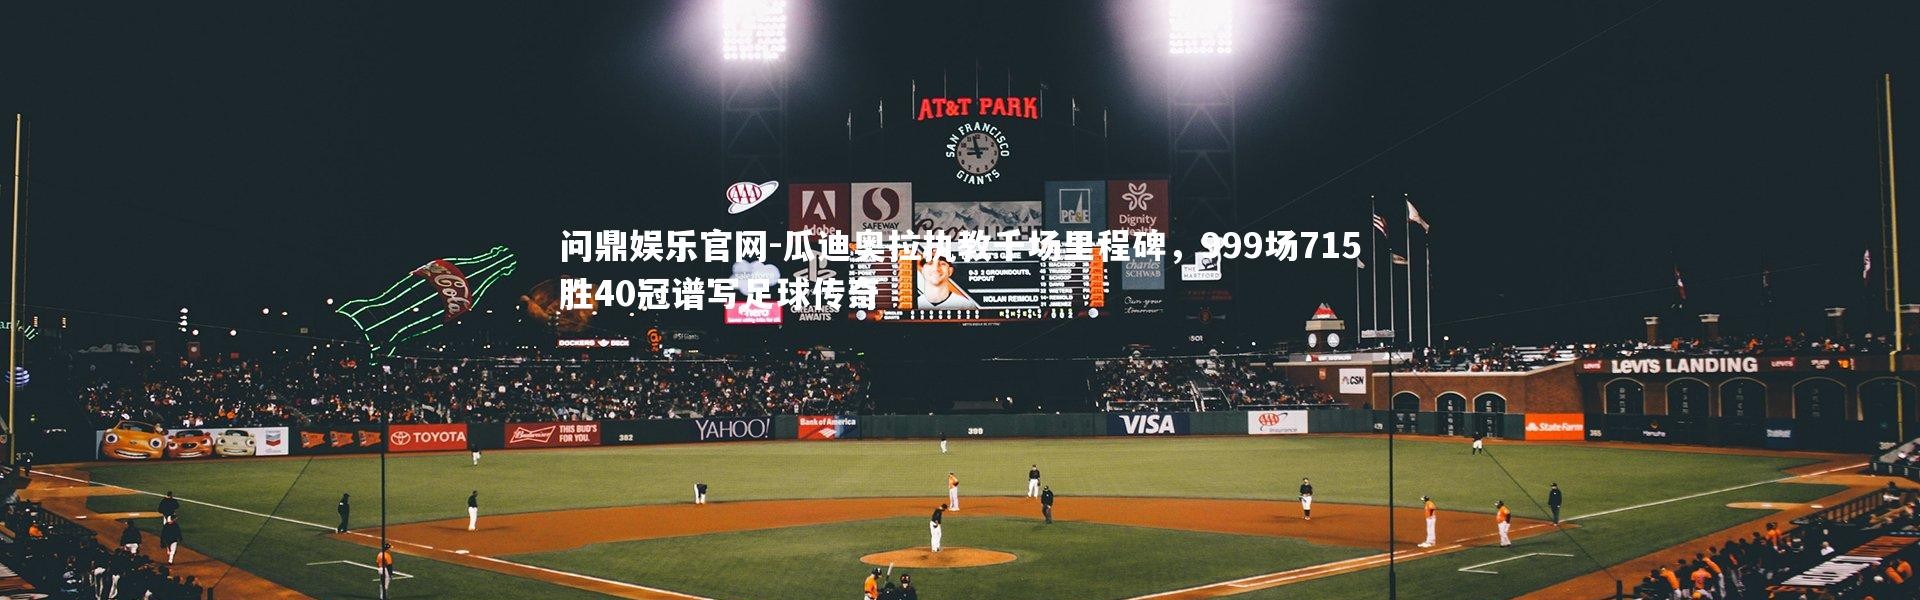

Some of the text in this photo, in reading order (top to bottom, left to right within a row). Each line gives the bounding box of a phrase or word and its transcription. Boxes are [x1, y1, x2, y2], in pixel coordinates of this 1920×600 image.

[918, 96, 1038, 120] AT&T PARK
[946, 122, 1010, 158] SAN FRANCISCO
[956, 169, 1001, 185] GIANTS
[1061, 209, 1090, 222] PG&E
[1119, 214, 1157, 227] Dignity
[862, 222, 899, 230] SAFEWAY
[985, 269, 1032, 277] GROUNDOUTS,
[1125, 270, 1161, 278] SCHWAB
[1008, 295, 1039, 303] REIMOLD
[1143, 299, 1162, 308] your
[799, 313, 831, 321] AWAITS
[1666, 357, 1758, 373] LANDING
[1350, 376, 1364, 385] CSN
[826, 418, 856, 426] America
[1119, 415, 1175, 434] VISA
[560, 424, 597, 434] THIS BUD'S
[695, 418, 770, 440] YAHOO!
[413, 431, 466, 443] TOYOTA
[515, 430, 550, 439] Budweiser
[560, 433, 590, 442] FOR YOU.
